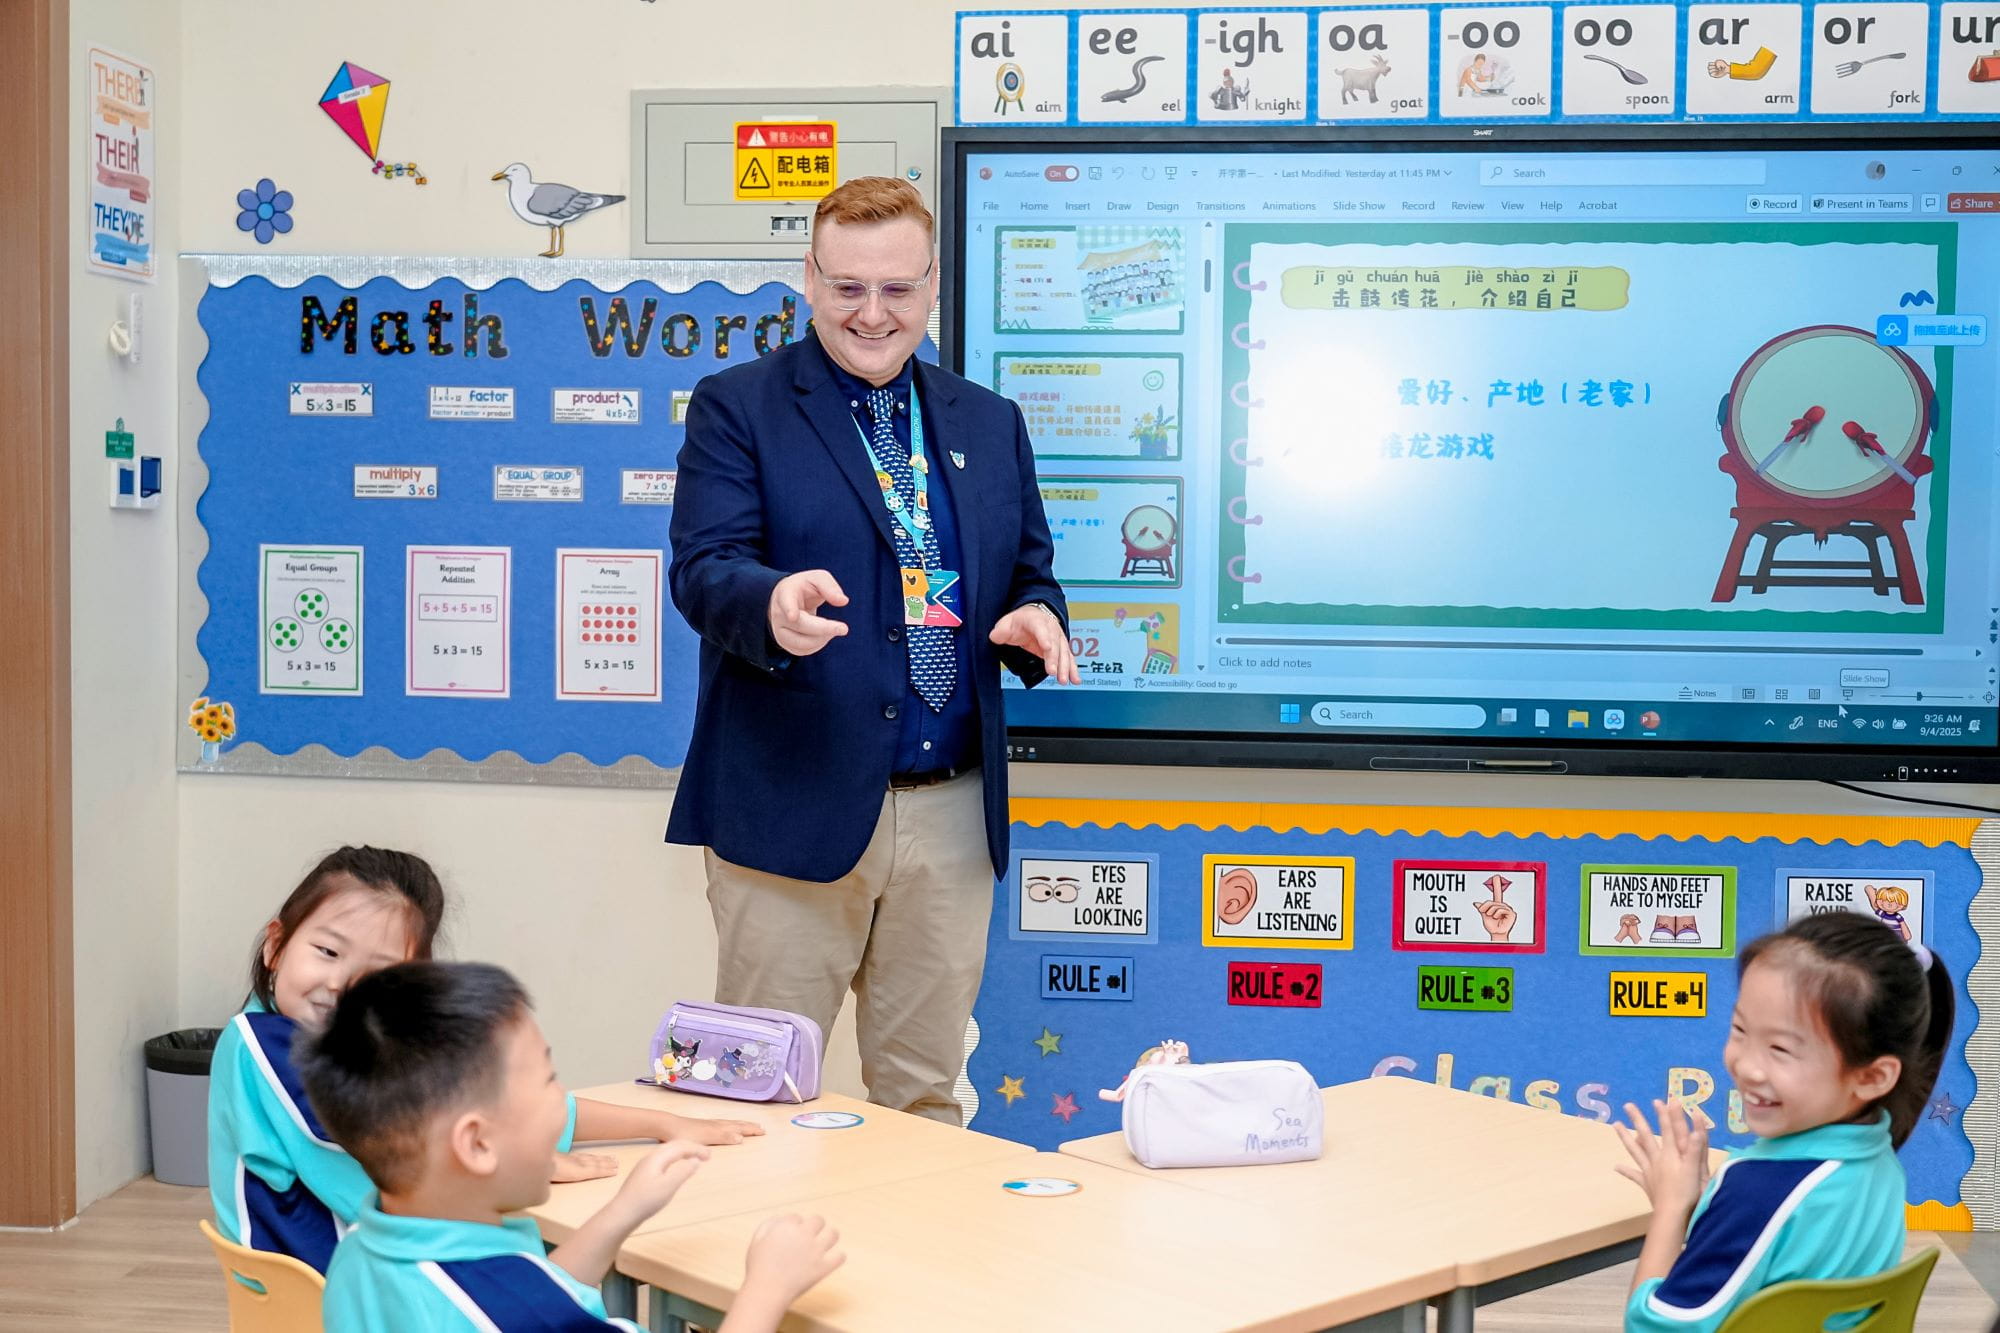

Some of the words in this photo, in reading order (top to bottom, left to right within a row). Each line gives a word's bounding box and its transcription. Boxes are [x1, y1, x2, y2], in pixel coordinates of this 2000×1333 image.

[1447, 20, 1520, 49] -oo
[1574, 18, 1632, 46] oo
[1698, 16, 1749, 45] ar
[1823, 16, 1875, 45] or
[971, 20, 1015, 58] ai
[1088, 27, 1138, 54] ee
[1204, 17, 1284, 67] -igh
[1329, 24, 1388, 51] oa
[95, 63, 143, 104] THERE
[1511, 93, 1546, 107] cook
[1625, 95, 1670, 109] spoon
[1764, 93, 1794, 105] arm
[1888, 90, 1921, 108] fork
[1035, 100, 1062, 113] aim
[1161, 99, 1181, 112] eel
[1255, 98, 1301, 115] knight
[1390, 98, 1424, 113] goat
[95, 133, 140, 173] THEIR
[777, 154, 830, 174] 配电箱
[1004, 169, 1040, 178] AutoSave
[1049, 170, 1062, 178] On
[1281, 169, 1299, 178] Last
[1302, 169, 1341, 178] Modified:
[1345, 169, 1386, 180] Yesterday
[1400, 169, 1423, 178] 11:45
[1426, 169, 1440, 178] PM
[1513, 168, 1546, 178] Search
[983, 201, 999, 211] File
[1020, 201, 1049, 211] Home
[1065, 201, 1091, 211] Insert
[1107, 201, 1132, 211] Draw
[1147, 201, 1179, 213] Design
[1196, 201, 1246, 211] Transitions
[1262, 201, 1317, 211] Animations
[1333, 201, 1357, 210] Slide
[1359, 201, 1386, 210] Show
[1402, 201, 1435, 210] Record
[1451, 201, 1485, 210] Review
[1501, 201, 1524, 210] View
[1540, 201, 1563, 212] Help
[1579, 201, 1618, 210] Acrobat
[1763, 199, 1797, 209] Record
[1827, 199, 1864, 209] Present
[1866, 199, 1875, 209] in
[1878, 199, 1909, 209] Teams
[1965, 199, 1993, 209] Share
[95, 203, 145, 238] THEY'RE
[976, 223, 982, 233] 4
[1366, 270, 1408, 283] chuán
[1415, 270, 1440, 283] huā
[1465, 270, 1483, 285] jiè
[1496, 270, 1530, 283] shào
[1542, 270, 1555, 283] zì
[1332, 288, 1577, 309] 击鼓传花，介绍自己
[301, 293, 509, 360] Math
[579, 294, 816, 360] Word
[975, 349, 981, 359] 5
[469, 390, 508, 402] factor
[572, 391, 621, 406] product
[306, 398, 315, 412] 5
[326, 398, 334, 412] 3
[344, 398, 356, 412] 15
[606, 409, 611, 418] 4
[627, 409, 637, 419] 20
[369, 468, 422, 482] multiply
[508, 470, 535, 480] EQUAL
[543, 471, 572, 480] GROUP
[656, 473, 678, 482] prop
[408, 484, 416, 496] 3
[427, 484, 435, 496] 6
[285, 563, 308, 574] Equal
[309, 563, 338, 574] Groups
[439, 564, 475, 575] Repeated
[600, 567, 620, 578] Array
[441, 575, 475, 584] Addition
[424, 602, 430, 612] 5
[442, 602, 449, 613] 5
[461, 603, 467, 613] 5
[481, 603, 492, 614] 15
[433, 645, 440, 655] 5
[451, 645, 458, 655] 3
[471, 645, 483, 656] 15
[1069, 637, 1100, 657] 02
[287, 660, 294, 671] 5
[305, 661, 311, 671] 3
[325, 661, 336, 671] 15
[584, 659, 591, 669] 5
[602, 660, 609, 669] 3
[623, 660, 634, 670] 15
[1218, 656, 1243, 668] Click
[1246, 657, 1257, 668] to
[1260, 657, 1280, 668] add
[1283, 658, 1312, 668] notes
[1097, 678, 1122, 687] States)
[1148, 679, 1194, 689] Accessibility:
[1196, 680, 1216, 688] Good
[1228, 682, 1238, 690] go
[1843, 674, 1862, 683] Slide
[1865, 675, 1886, 684] Show
[1693, 689, 1717, 698] Notes
[1339, 709, 1373, 720] Search
[1924, 714, 1944, 723] 9:26
[1946, 714, 1963, 723] AM
[1818, 719, 1838, 729] ENG
[1920, 727, 1962, 737] 9/4/2025
[1092, 864, 1126, 883] EYES
[1278, 870, 1317, 888] EARS
[1412, 873, 1466, 892] MOUTH
[1603, 876, 1648, 892] HANDS
[1650, 877, 1678, 893] AND
[1680, 877, 1710, 893] FEET
[1095, 888, 1123, 905] ARE
[1805, 883, 1853, 902] RAISE
[1283, 892, 1311, 910] ARE
[1429, 895, 1447, 913] IS
[1610, 892, 1634, 908] ARE
[1636, 892, 1654, 908] TO
[1656, 893, 1703, 909] MYSELF
[1074, 908, 1143, 927] LOOKING
[1257, 912, 1337, 932] LISTENING
[1415, 917, 1461, 935] QUIET
[1048, 964, 1101, 993] RULE
[1231, 971, 1283, 999] RULE
[1421, 975, 1475, 1003] RULE
[1613, 981, 1668, 1009] RULE
[1272, 1107, 1303, 1131] Sea
[1245, 1133, 1309, 1153] Moments
